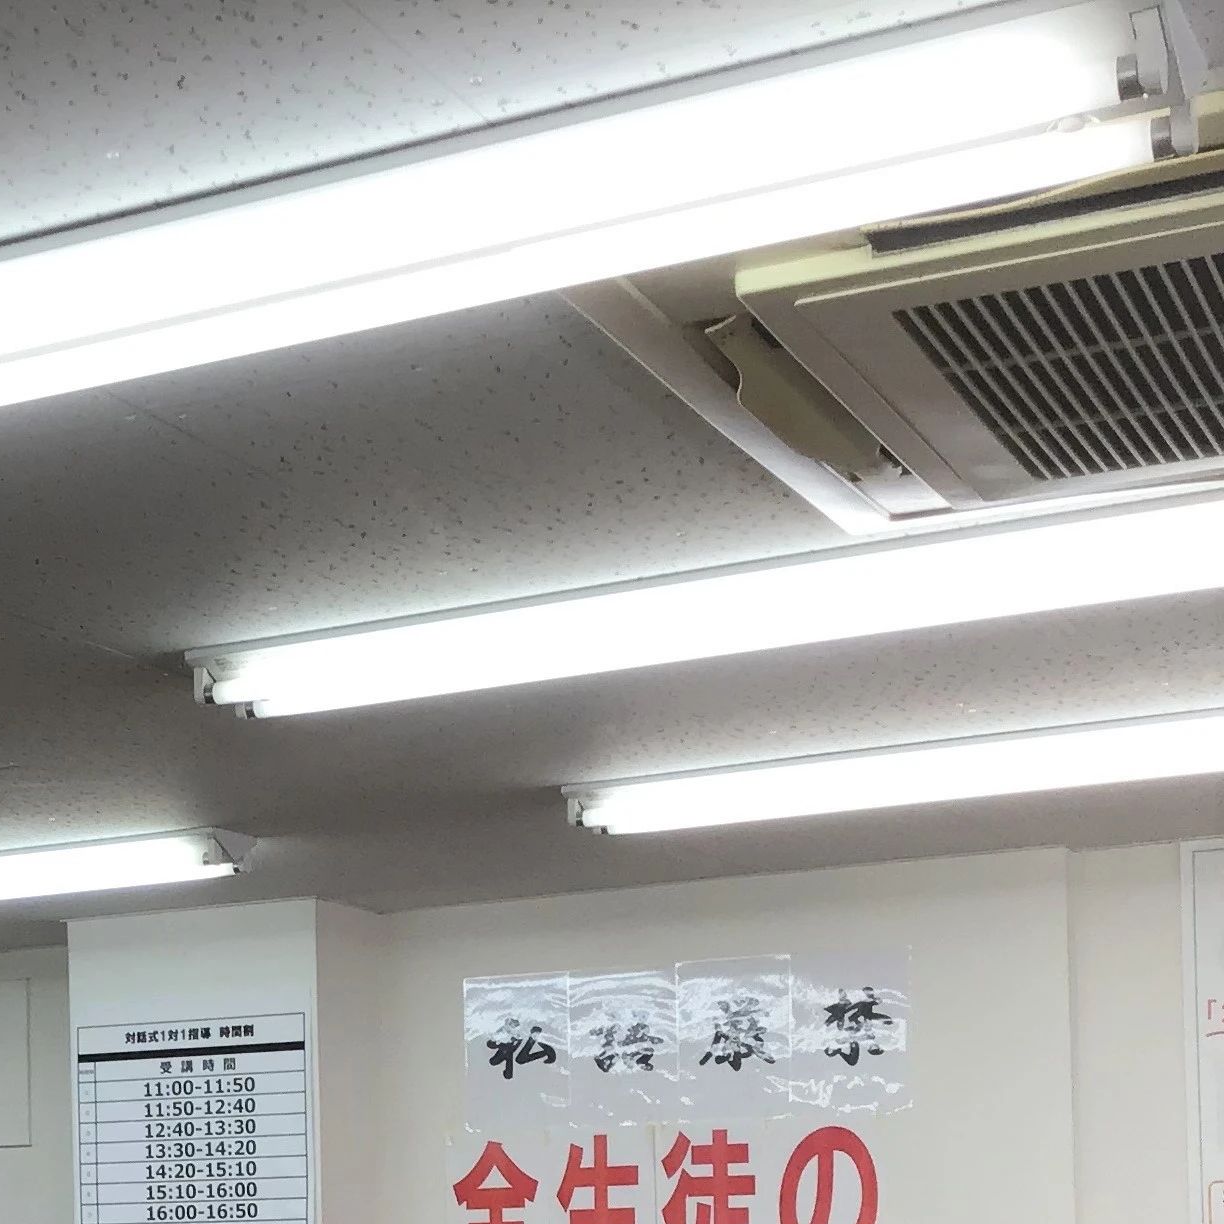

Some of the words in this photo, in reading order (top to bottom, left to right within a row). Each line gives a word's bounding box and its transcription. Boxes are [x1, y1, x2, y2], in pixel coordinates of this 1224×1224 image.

[144, 1077, 255, 1097] 11:00-11:50
[144, 1099, 256, 1118] 11:50-12:40
[145, 1119, 256, 1139] 12:40-13:30
[145, 1141, 256, 1159] 13:30-14:20
[145, 1162, 257, 1179] 14:20-15:10
[146, 1183, 257, 1200] 15:10-16:00
[146, 1204, 258, 1221] 16:00-16:50
